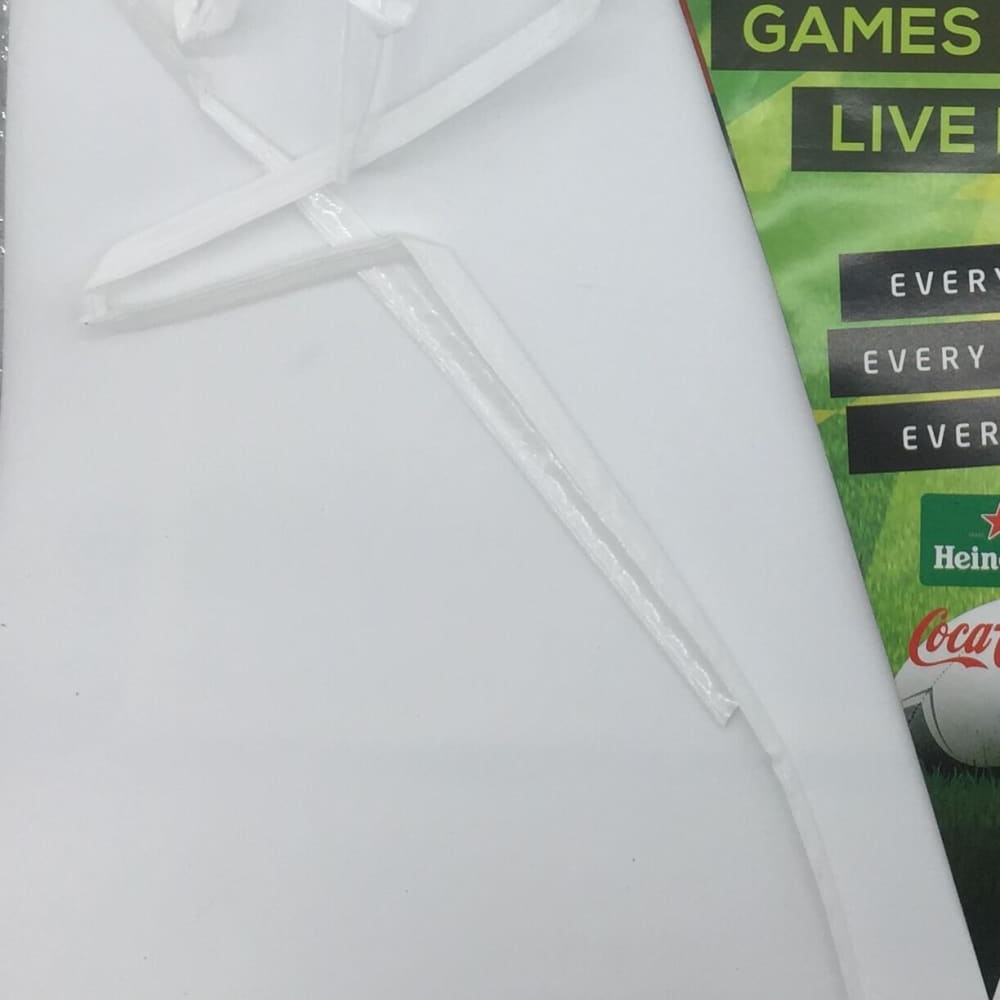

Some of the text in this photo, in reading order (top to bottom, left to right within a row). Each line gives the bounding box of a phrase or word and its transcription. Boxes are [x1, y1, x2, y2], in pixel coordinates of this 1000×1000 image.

[743, 3, 981, 56] GAMES
[831, 104, 976, 154] LIVE
[863, 344, 985, 375] EVERY
